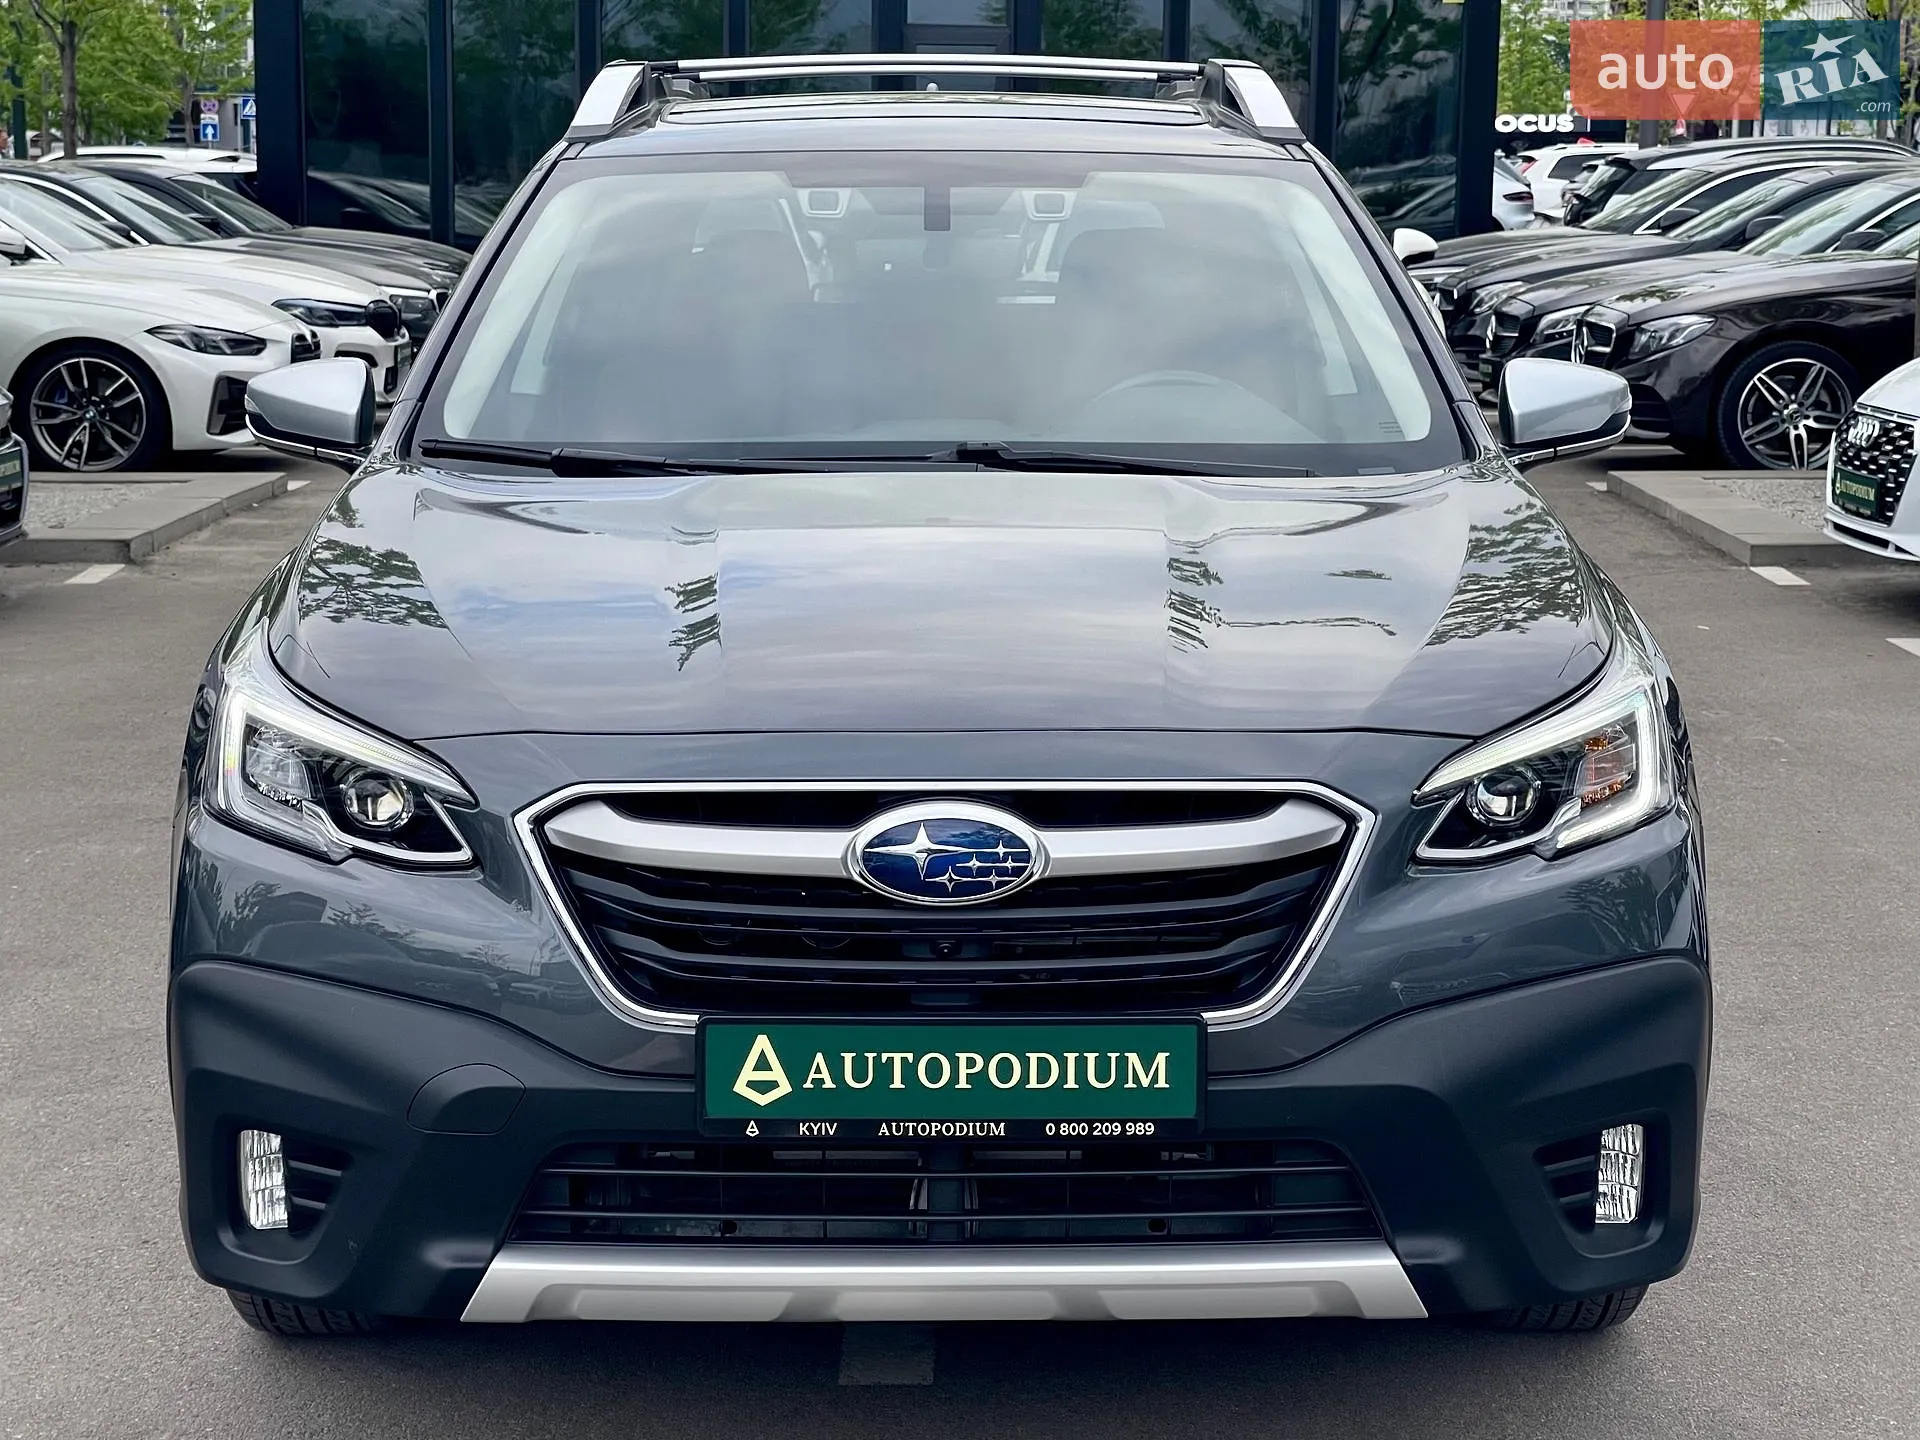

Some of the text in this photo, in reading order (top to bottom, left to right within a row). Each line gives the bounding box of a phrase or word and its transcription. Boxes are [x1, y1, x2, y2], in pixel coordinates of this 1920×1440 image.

[803, 1052, 1171, 1089] AUTOPODIUM
[799, 1122, 1155, 1137] KYIV AUTOPODIUM 0 800 209 989
